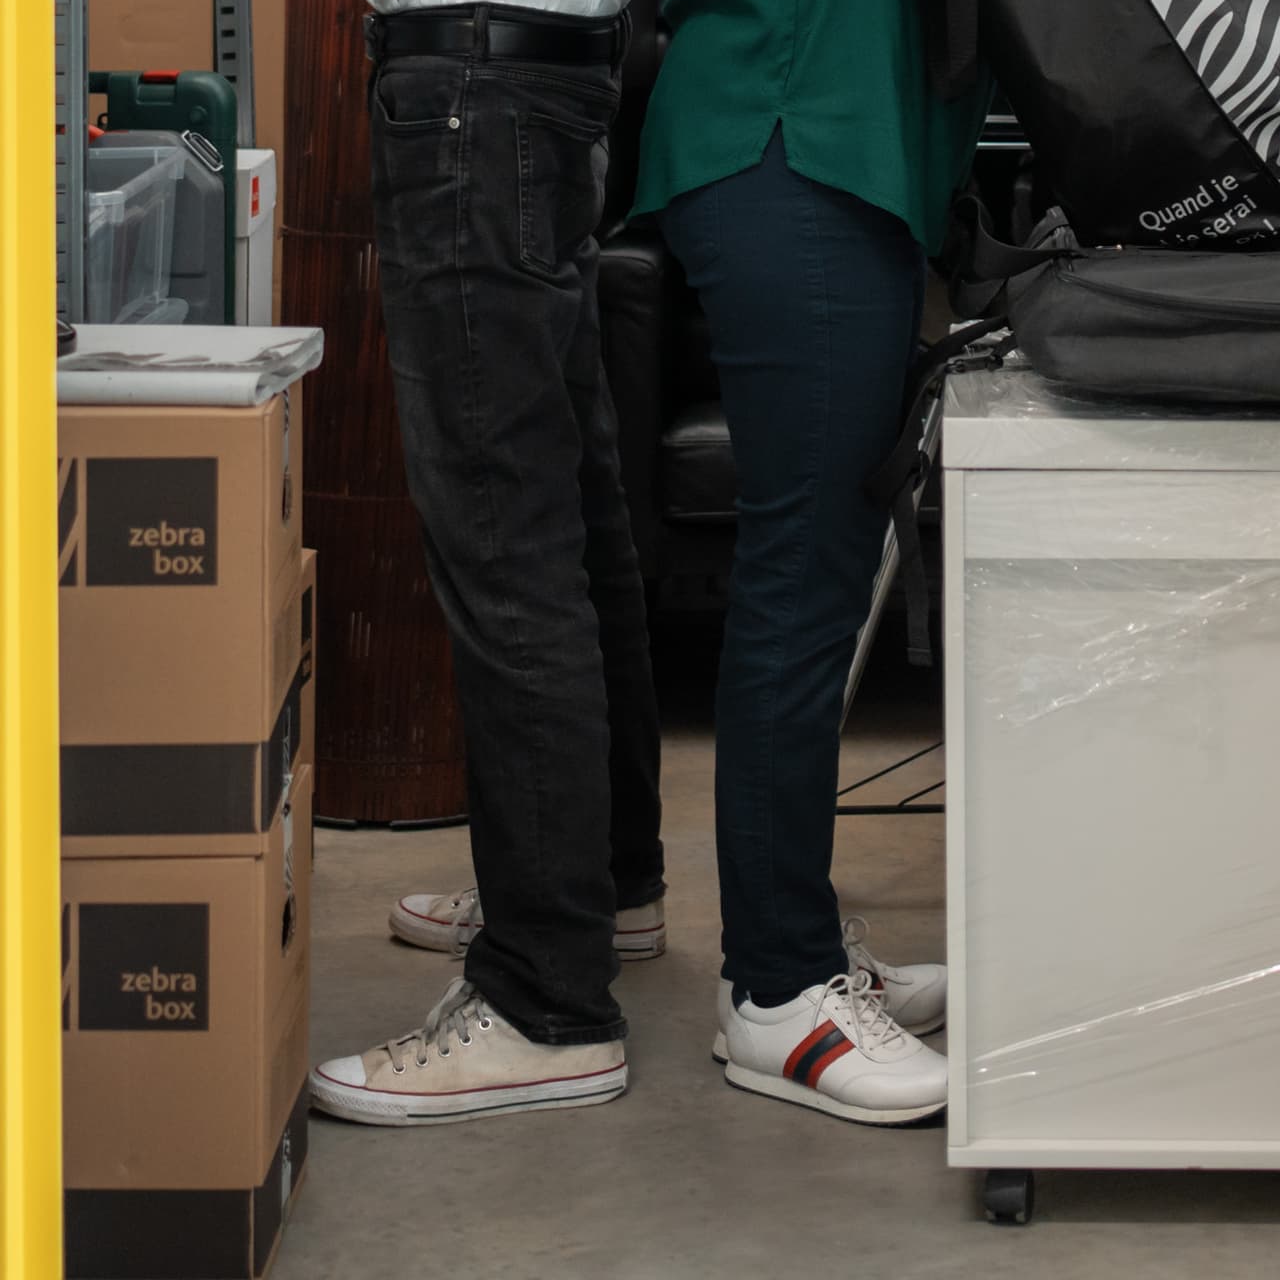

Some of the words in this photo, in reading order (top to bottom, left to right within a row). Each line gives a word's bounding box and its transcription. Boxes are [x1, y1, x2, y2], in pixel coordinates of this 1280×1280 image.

[1138, 184, 1214, 231] Quand
[1211, 174, 1240, 203] je
[129, 520, 206, 547] zebra
[153, 550, 204, 575] box
[121, 966, 197, 992] zebra
[146, 994, 196, 1020] box
